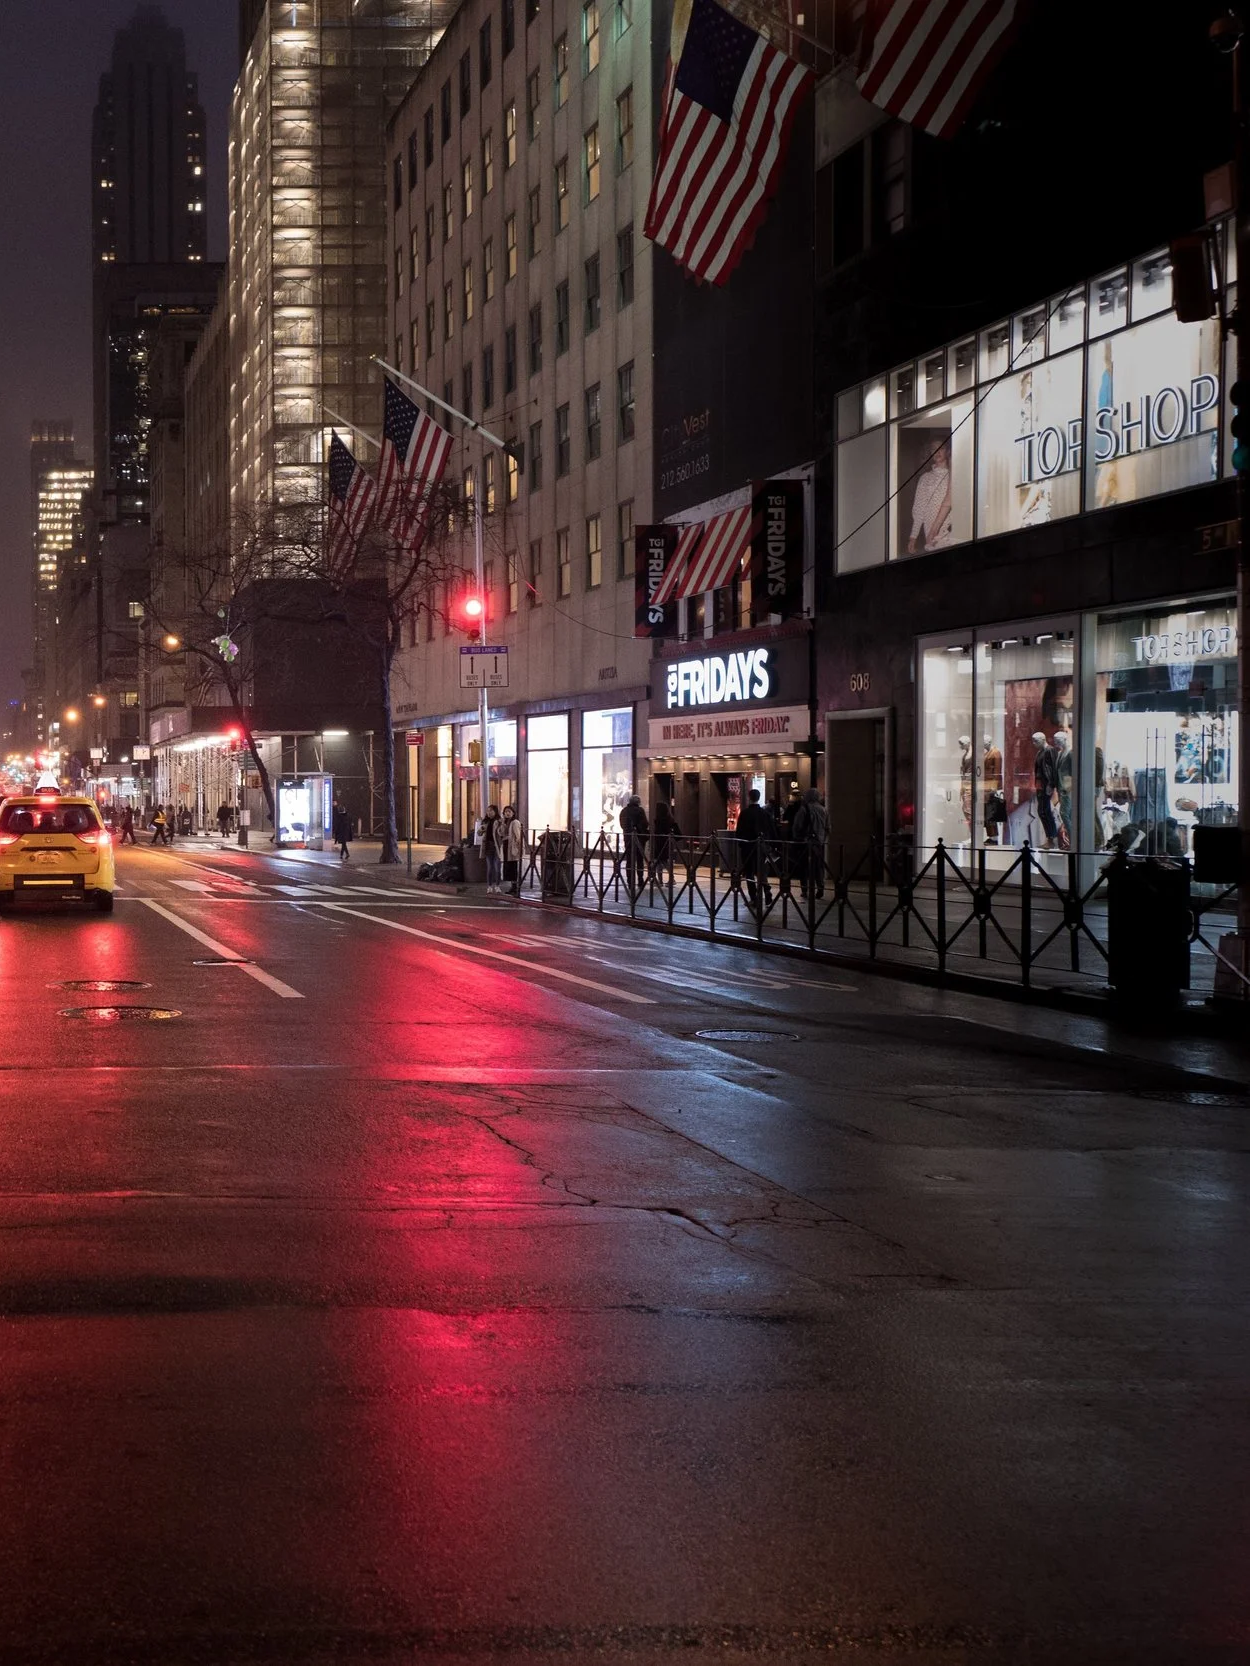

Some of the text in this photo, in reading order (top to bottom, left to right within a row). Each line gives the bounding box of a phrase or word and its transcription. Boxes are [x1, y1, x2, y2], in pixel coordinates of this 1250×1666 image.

[1014, 373, 1219, 484] TOPSHOP
[767, 495, 786, 506] TGI
[649, 538, 665, 548] TGI
[767, 507, 786, 597] FRIDAYS
[1130, 624, 1238, 661] TOPSHOP
[667, 648, 770, 709] TGI FRIDAYS
[850, 672, 870, 691] 608
[662, 725, 671, 740] IN
[673, 723, 695, 742] HERE,
[697, 720, 713, 738] IT'S
[714, 718, 749, 737] ALWAYS
